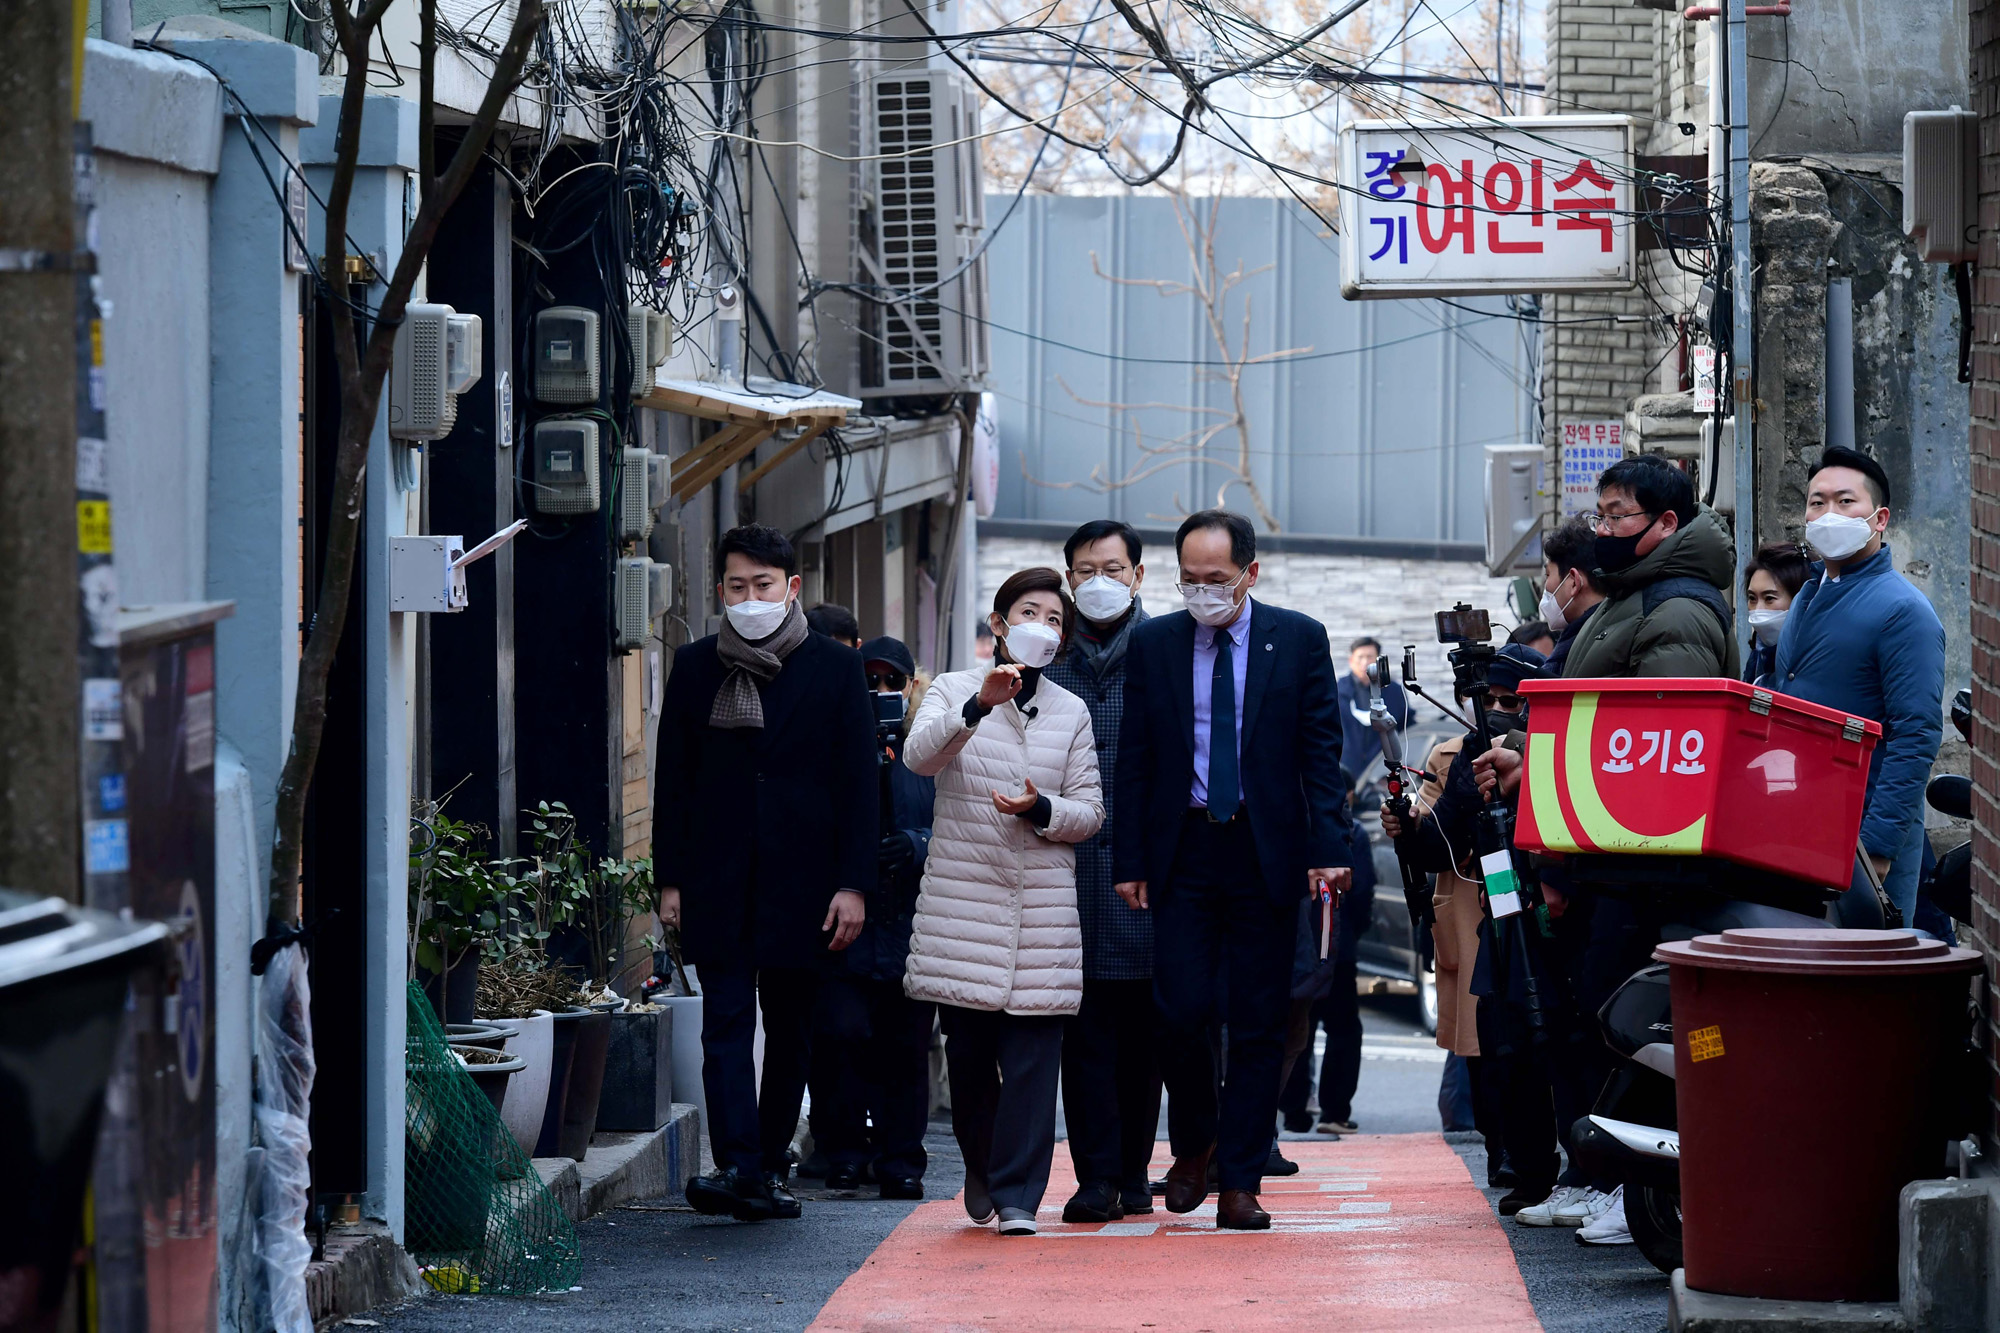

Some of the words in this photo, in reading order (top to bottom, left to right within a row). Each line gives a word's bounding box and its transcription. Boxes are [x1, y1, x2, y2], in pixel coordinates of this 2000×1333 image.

[1416, 158, 1616, 254] 여인숙
[1564, 424, 1591, 445] 전액
[1595, 424, 1621, 445] 무료
[1601, 728, 1706, 775] 요기요
[1648, 1023, 1674, 1031] SC
